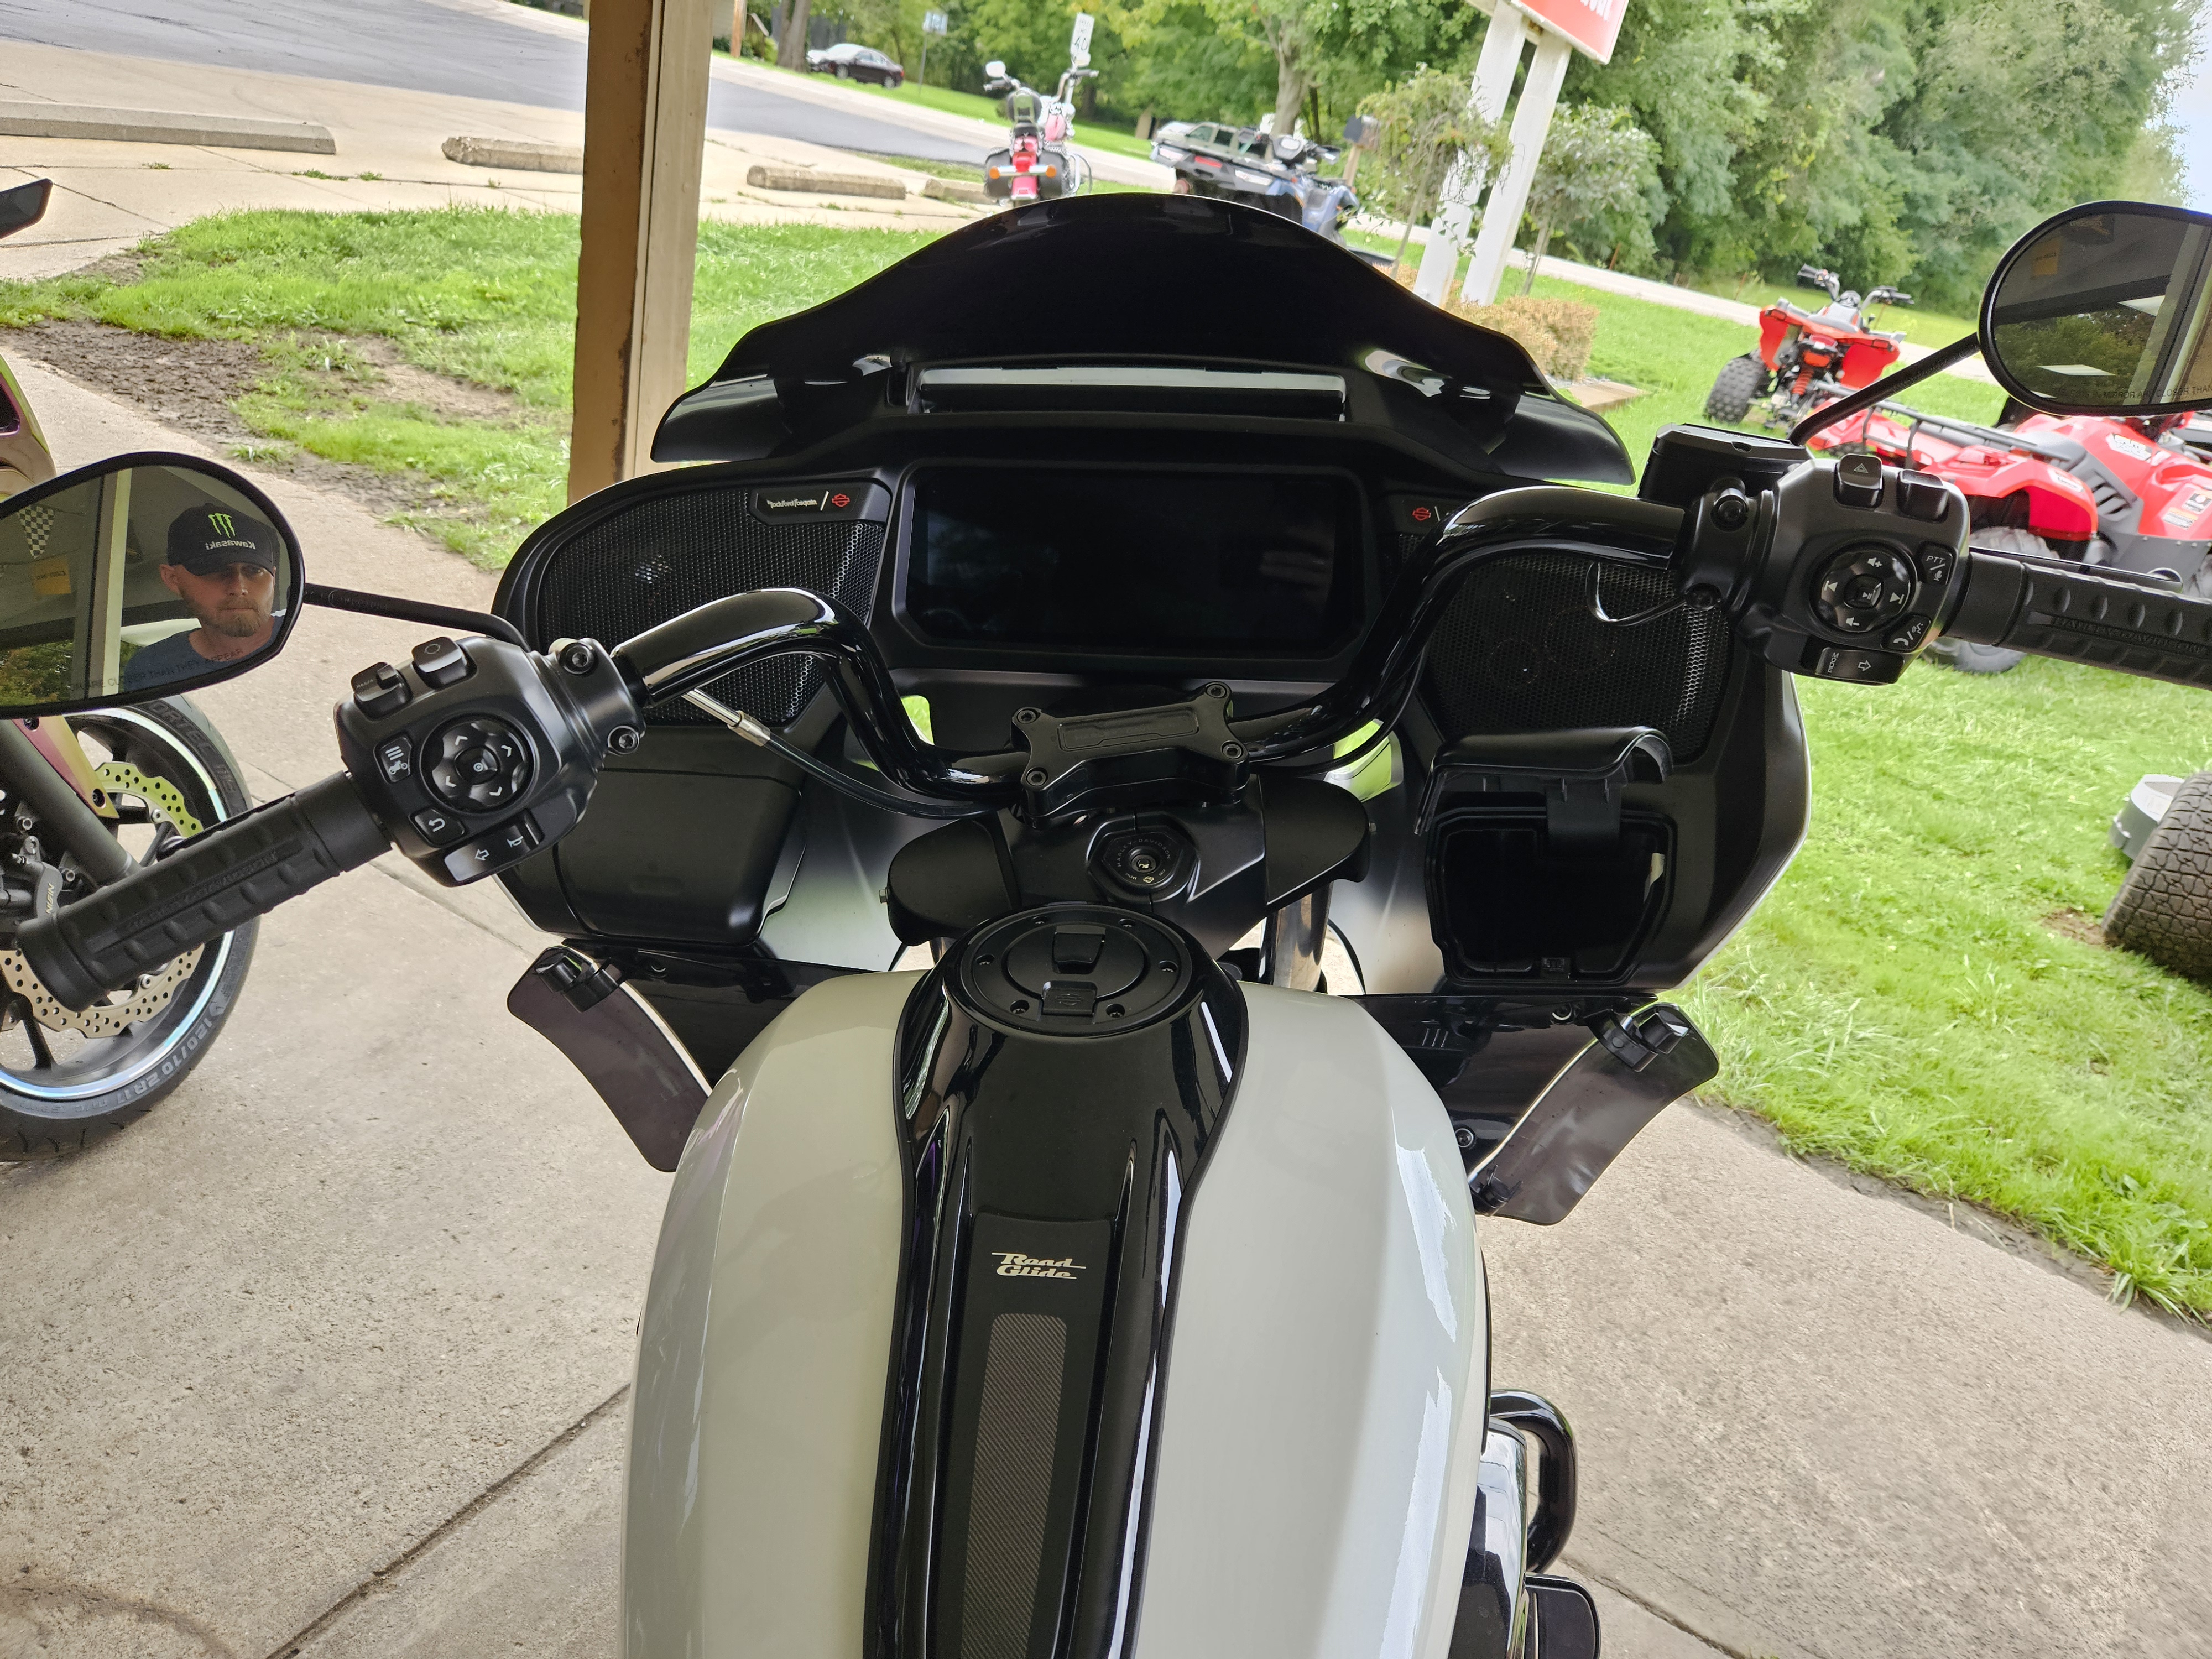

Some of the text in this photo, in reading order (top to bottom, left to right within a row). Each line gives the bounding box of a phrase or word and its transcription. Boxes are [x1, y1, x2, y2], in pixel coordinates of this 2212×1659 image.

[1926, 555, 1946, 564] PTT
[1827, 652, 1839, 673] MODE
[161, 1017, 213, 1076] 120/70
[992, 1252, 1087, 1269] Road
[997, 1265, 1077, 1280] Glide
